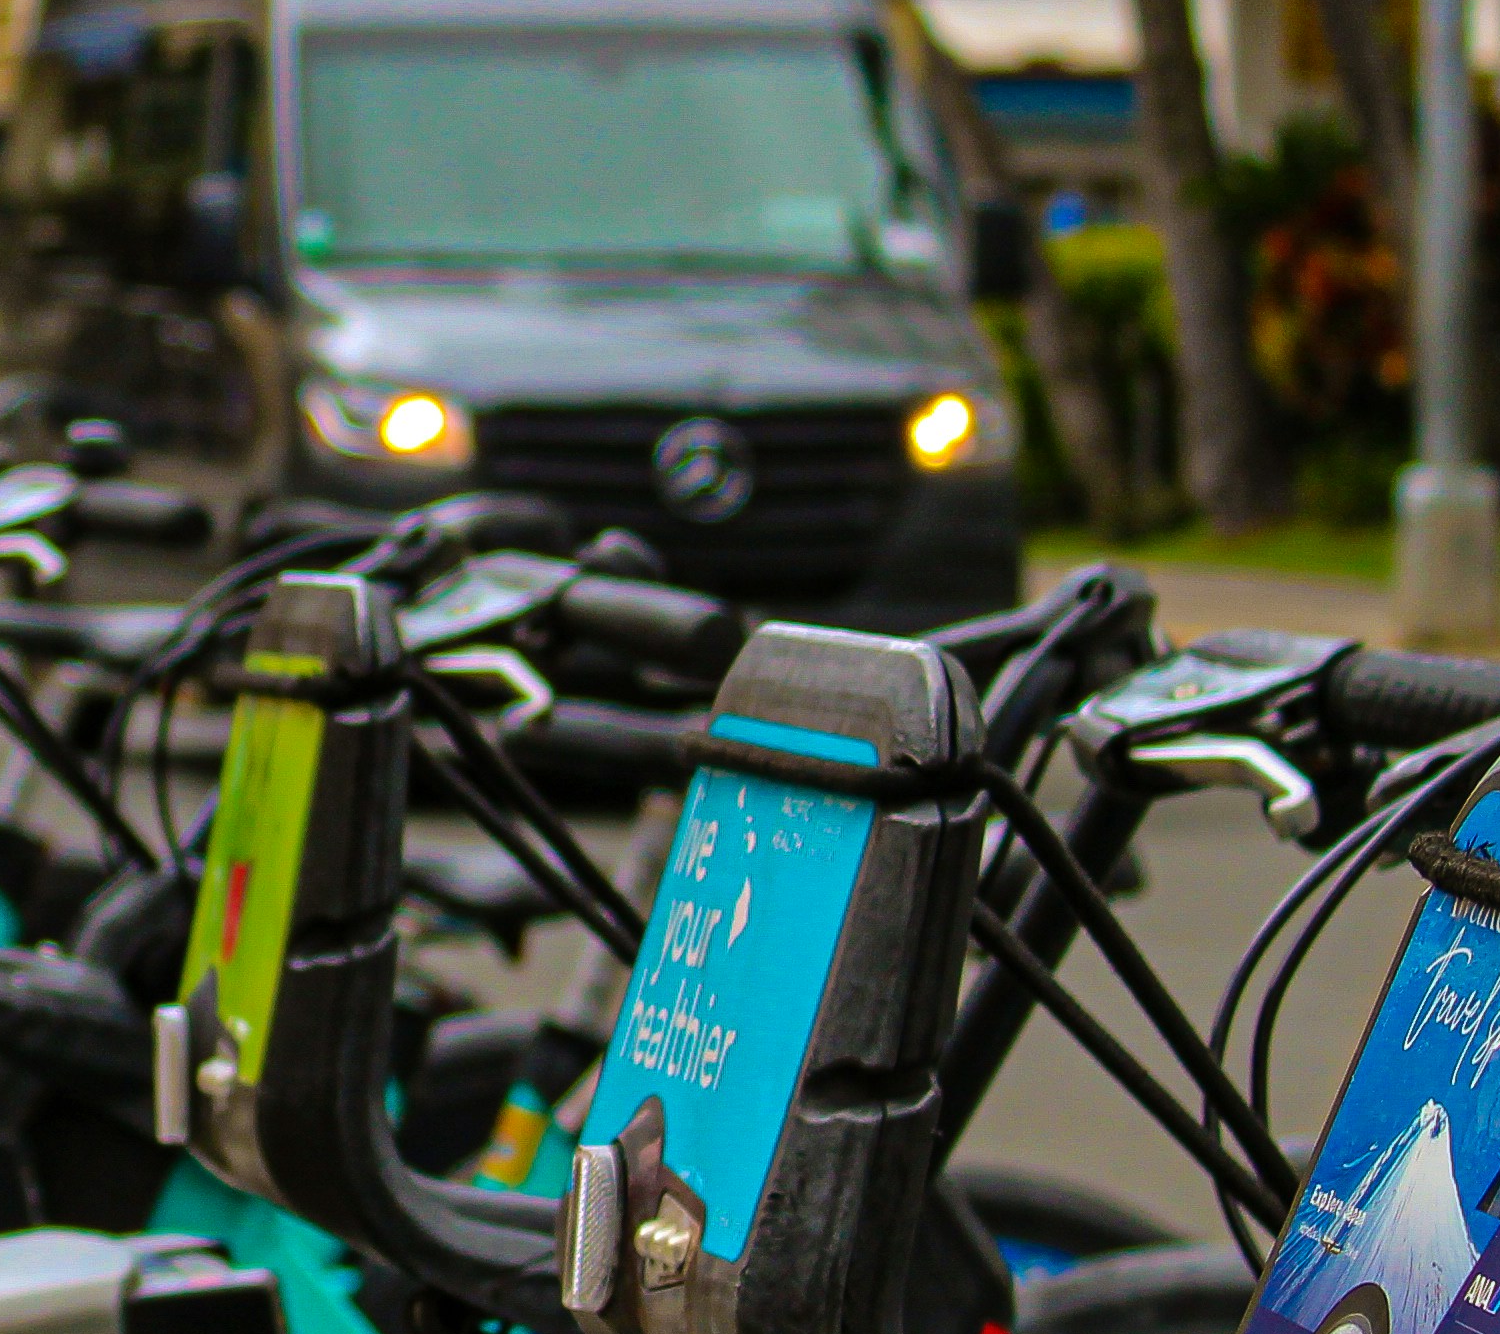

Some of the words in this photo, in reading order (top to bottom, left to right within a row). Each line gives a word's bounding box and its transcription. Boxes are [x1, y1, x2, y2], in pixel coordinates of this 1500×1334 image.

[673, 783, 719, 882] live
[650, 898, 722, 986] your
[619, 966, 737, 1092] healthier
[1463, 1273, 1496, 1311] ANA
